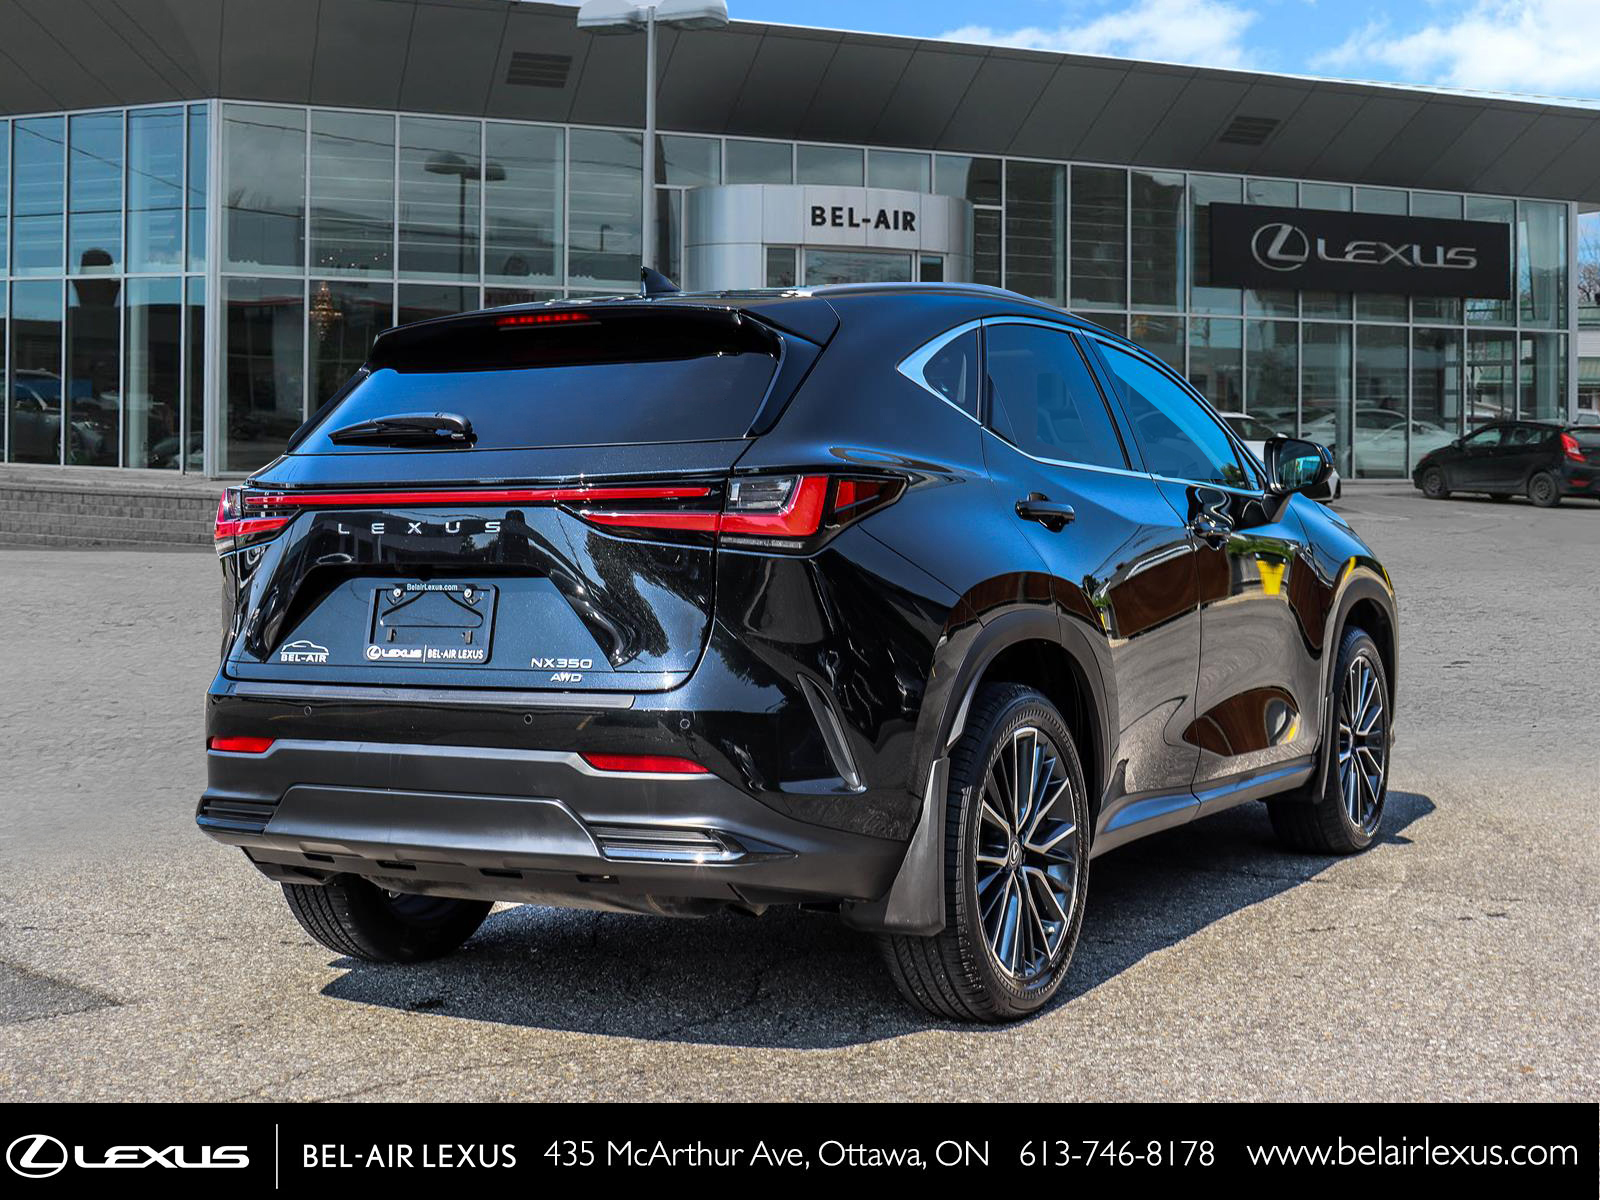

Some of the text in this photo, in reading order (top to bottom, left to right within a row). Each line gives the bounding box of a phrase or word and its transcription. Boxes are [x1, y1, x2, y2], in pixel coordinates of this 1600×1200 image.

[811, 205, 916, 232] BEL-AIR
[1316, 237, 1478, 270] LEXUS
[337, 521, 502, 535] LEXUS
[406, 583, 458, 591] BelairLexus.com
[280, 654, 327, 663] BEL-AIR
[381, 648, 422, 659] LEXUS
[458, 649, 484, 660] LEXUS
[550, 672, 583, 682] AWD
